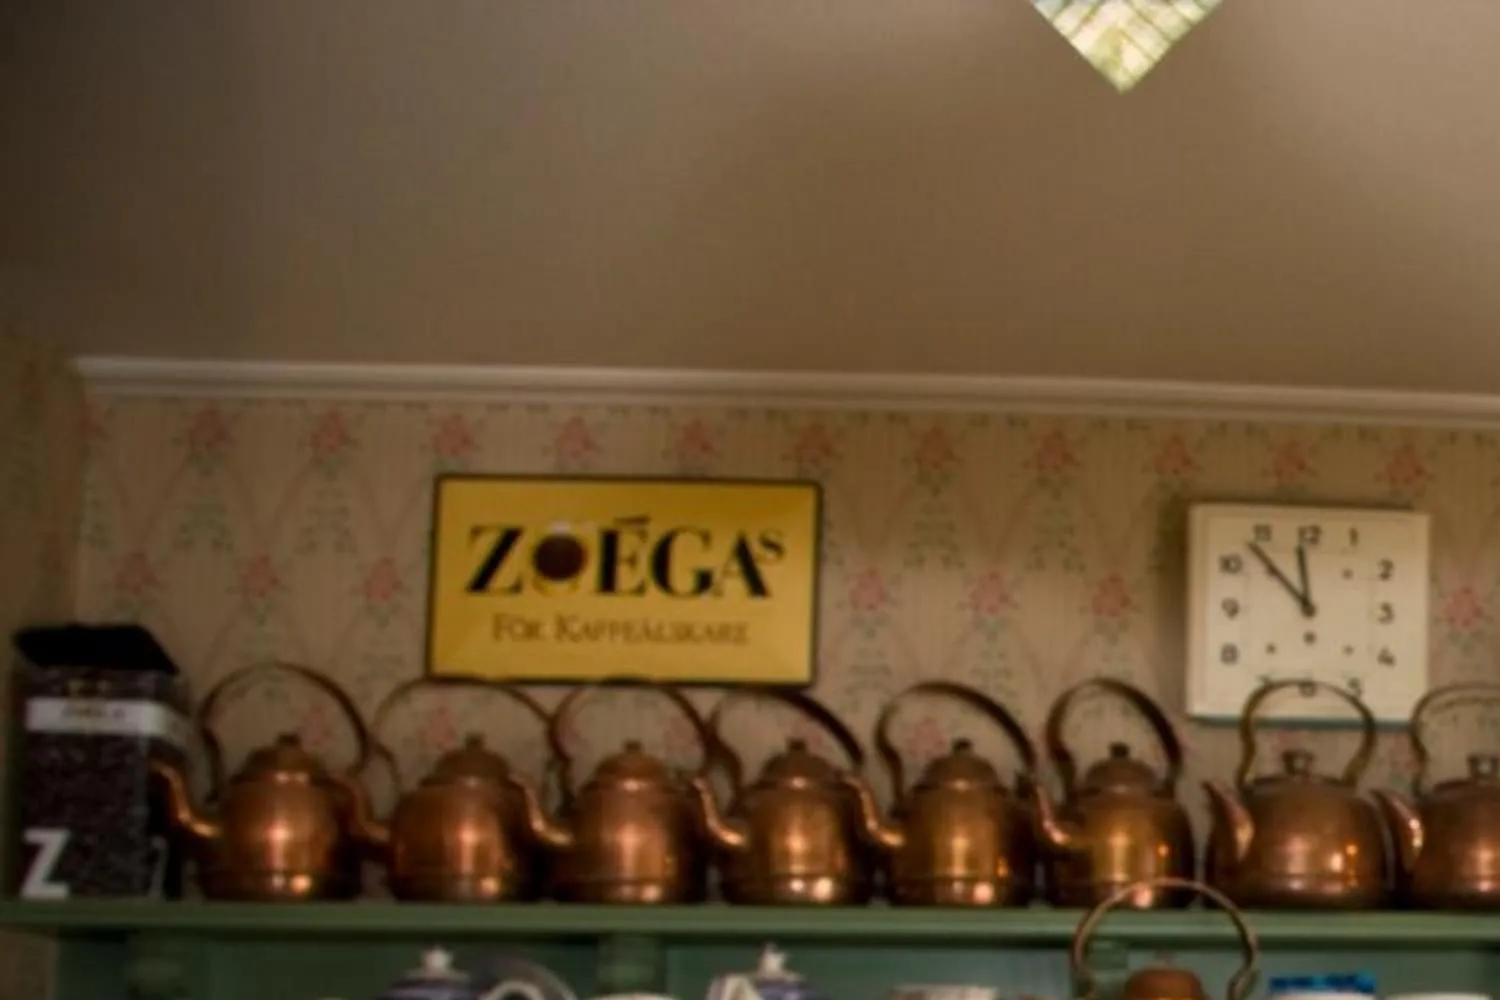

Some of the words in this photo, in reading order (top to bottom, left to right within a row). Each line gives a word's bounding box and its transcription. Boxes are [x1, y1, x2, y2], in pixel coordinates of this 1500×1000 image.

[1298, 525, 1323, 545] 12
[1349, 528, 1360, 547] 1
[1377, 559, 1394, 581] 2
[1221, 597, 1240, 620] 9
[1377, 602, 1395, 625] 3
[1377, 647, 1397, 667] 4
[19, 827, 70, 901] Z
